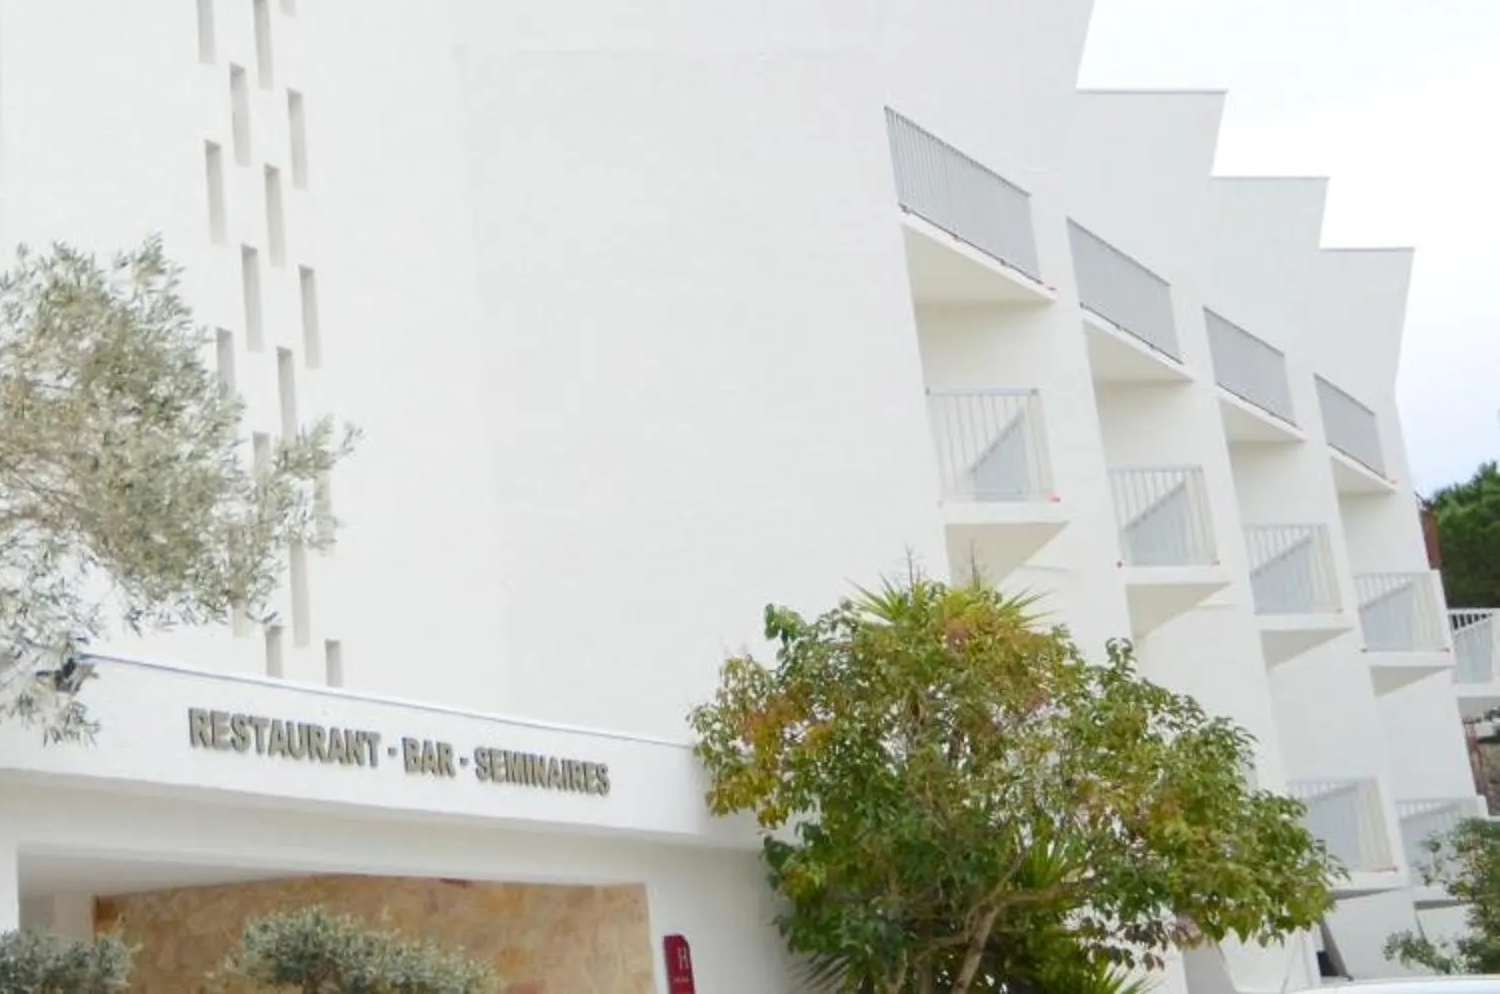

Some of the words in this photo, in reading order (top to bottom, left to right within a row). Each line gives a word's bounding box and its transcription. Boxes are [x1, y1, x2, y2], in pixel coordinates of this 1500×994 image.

[188, 707, 381, 767] RESTAURANT
[401, 737, 455, 778] BAR
[474, 746, 610, 795] SEMINAIRES
